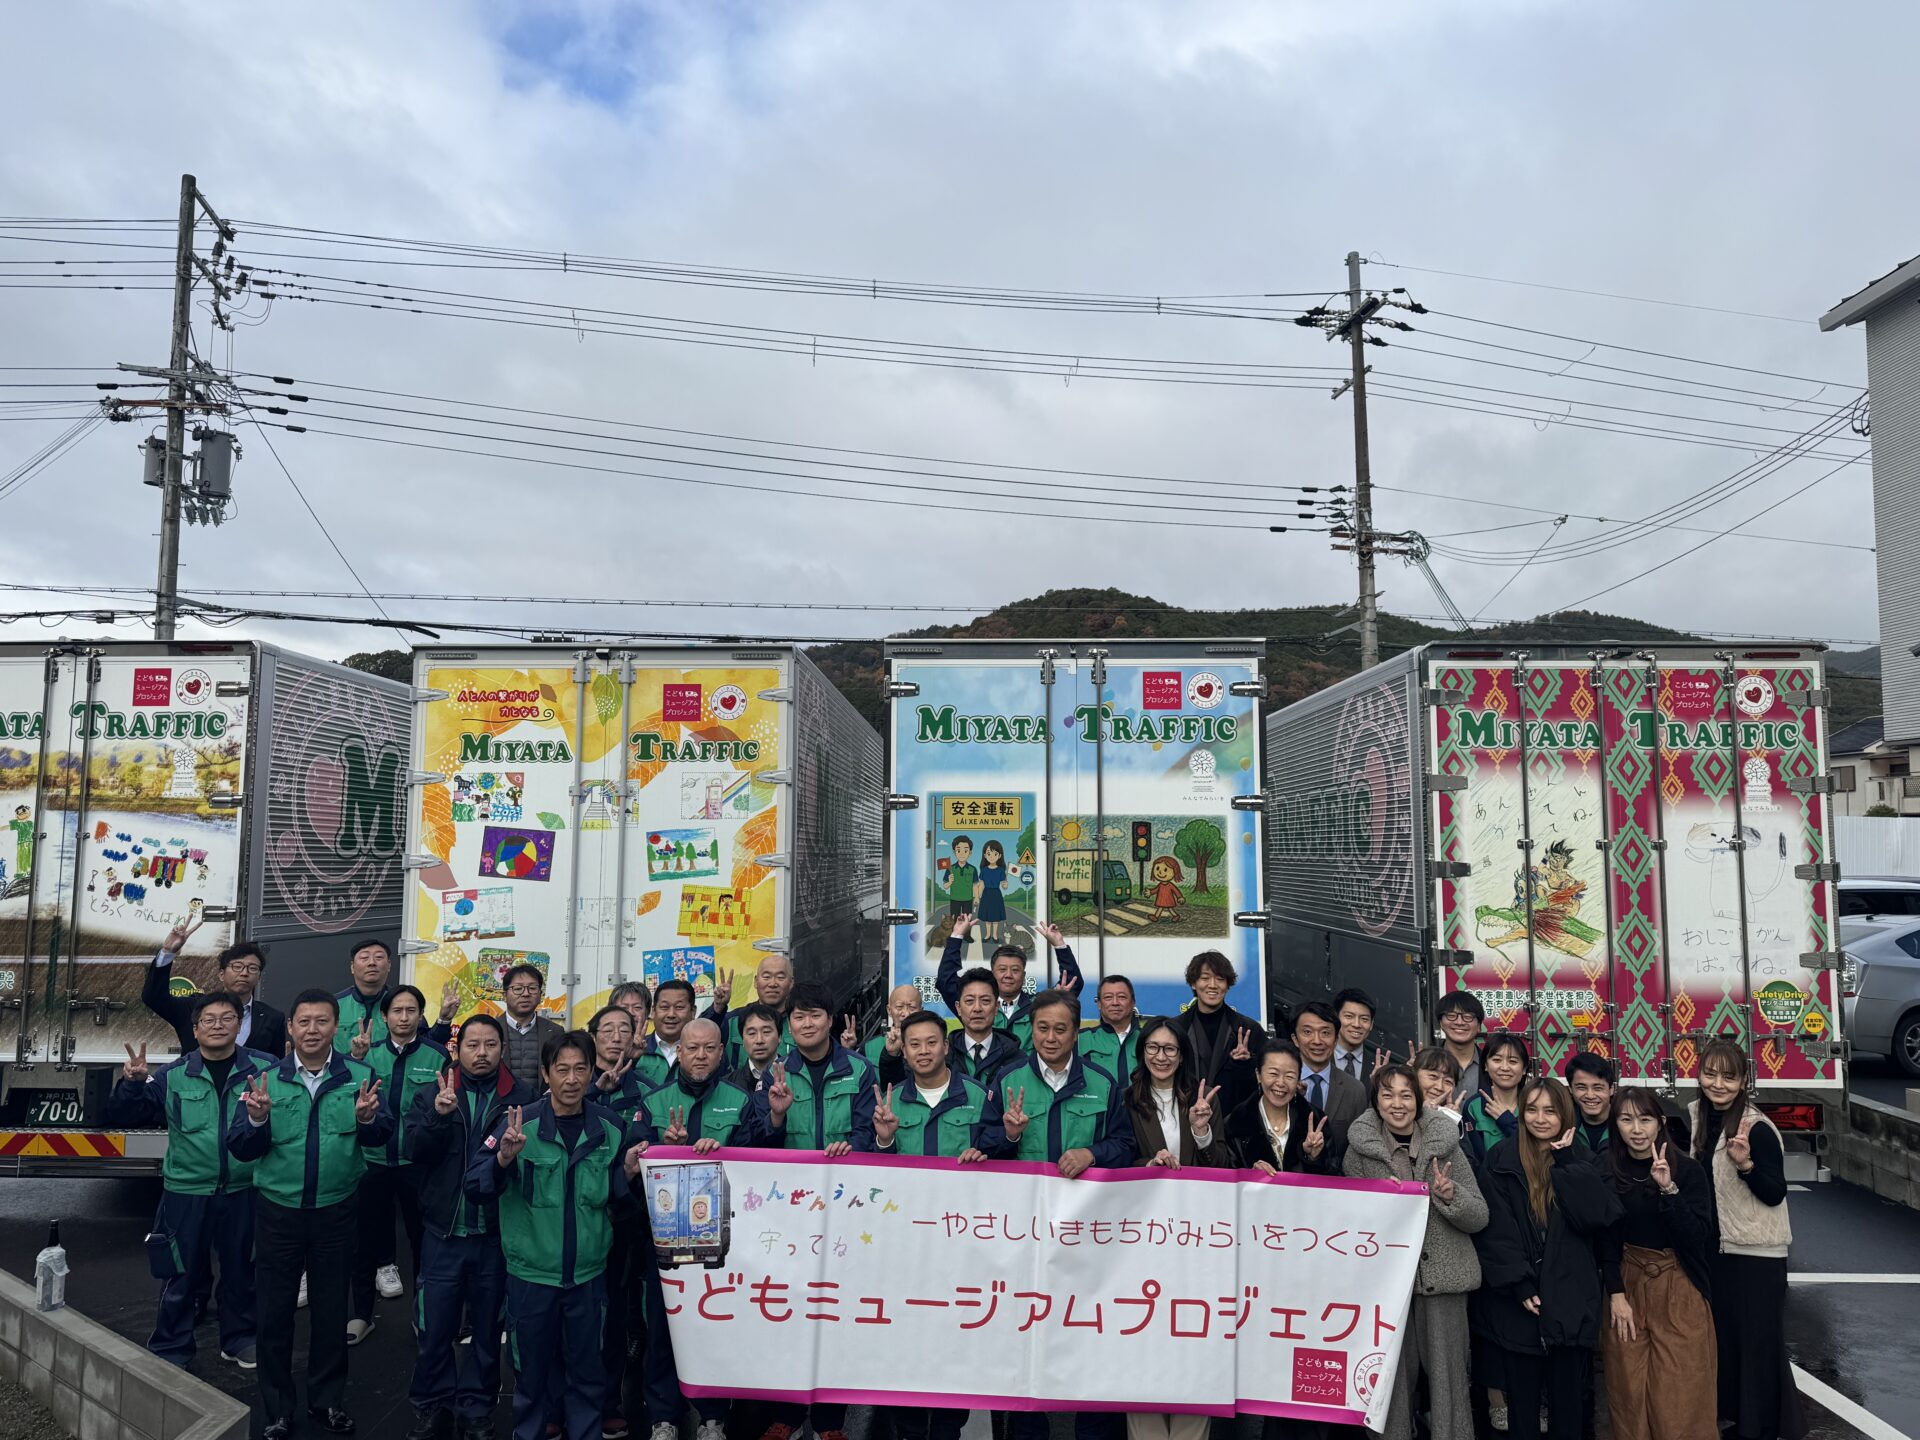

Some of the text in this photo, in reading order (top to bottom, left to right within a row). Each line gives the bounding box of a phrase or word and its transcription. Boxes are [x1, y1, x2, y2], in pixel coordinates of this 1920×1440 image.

[136, 674, 155, 682] こども
[136, 684, 169, 692] ミュージアム
[135, 692, 168, 701] プロジェクト
[457, 690, 540, 703] 人と人の繋がりが
[1145, 696, 1179, 704] プロジェクト
[1676, 701, 1711, 709] プロジェクト
[500, 706, 540, 718] 力となる
[665, 708, 699, 716] プロジェクト
[69, 701, 228, 740] TRAFFIC
[916, 704, 1238, 743] MIYATA TRAFFIC
[1455, 708, 1800, 749] MIYATA TRAFFIC
[458, 731, 760, 763] MIYATA TRAFFIC
[952, 801, 1014, 817] 安全運転
[956, 817, 968, 826] LÁI
[992, 817, 1010, 826] TOÀN
[1057, 856, 1092, 868] Miyata
[1056, 867, 1090, 880] traffic
[1682, 927, 1791, 946] おしごがん
[1753, 991, 1809, 999] Safety Drive
[660, 1272, 1397, 1348] こどもミュージアムプロジェクト
[1297, 1357, 1322, 1368] こども
[1296, 1370, 1343, 1383] ミュージアム
[1296, 1384, 1343, 1397] プロジェクト
